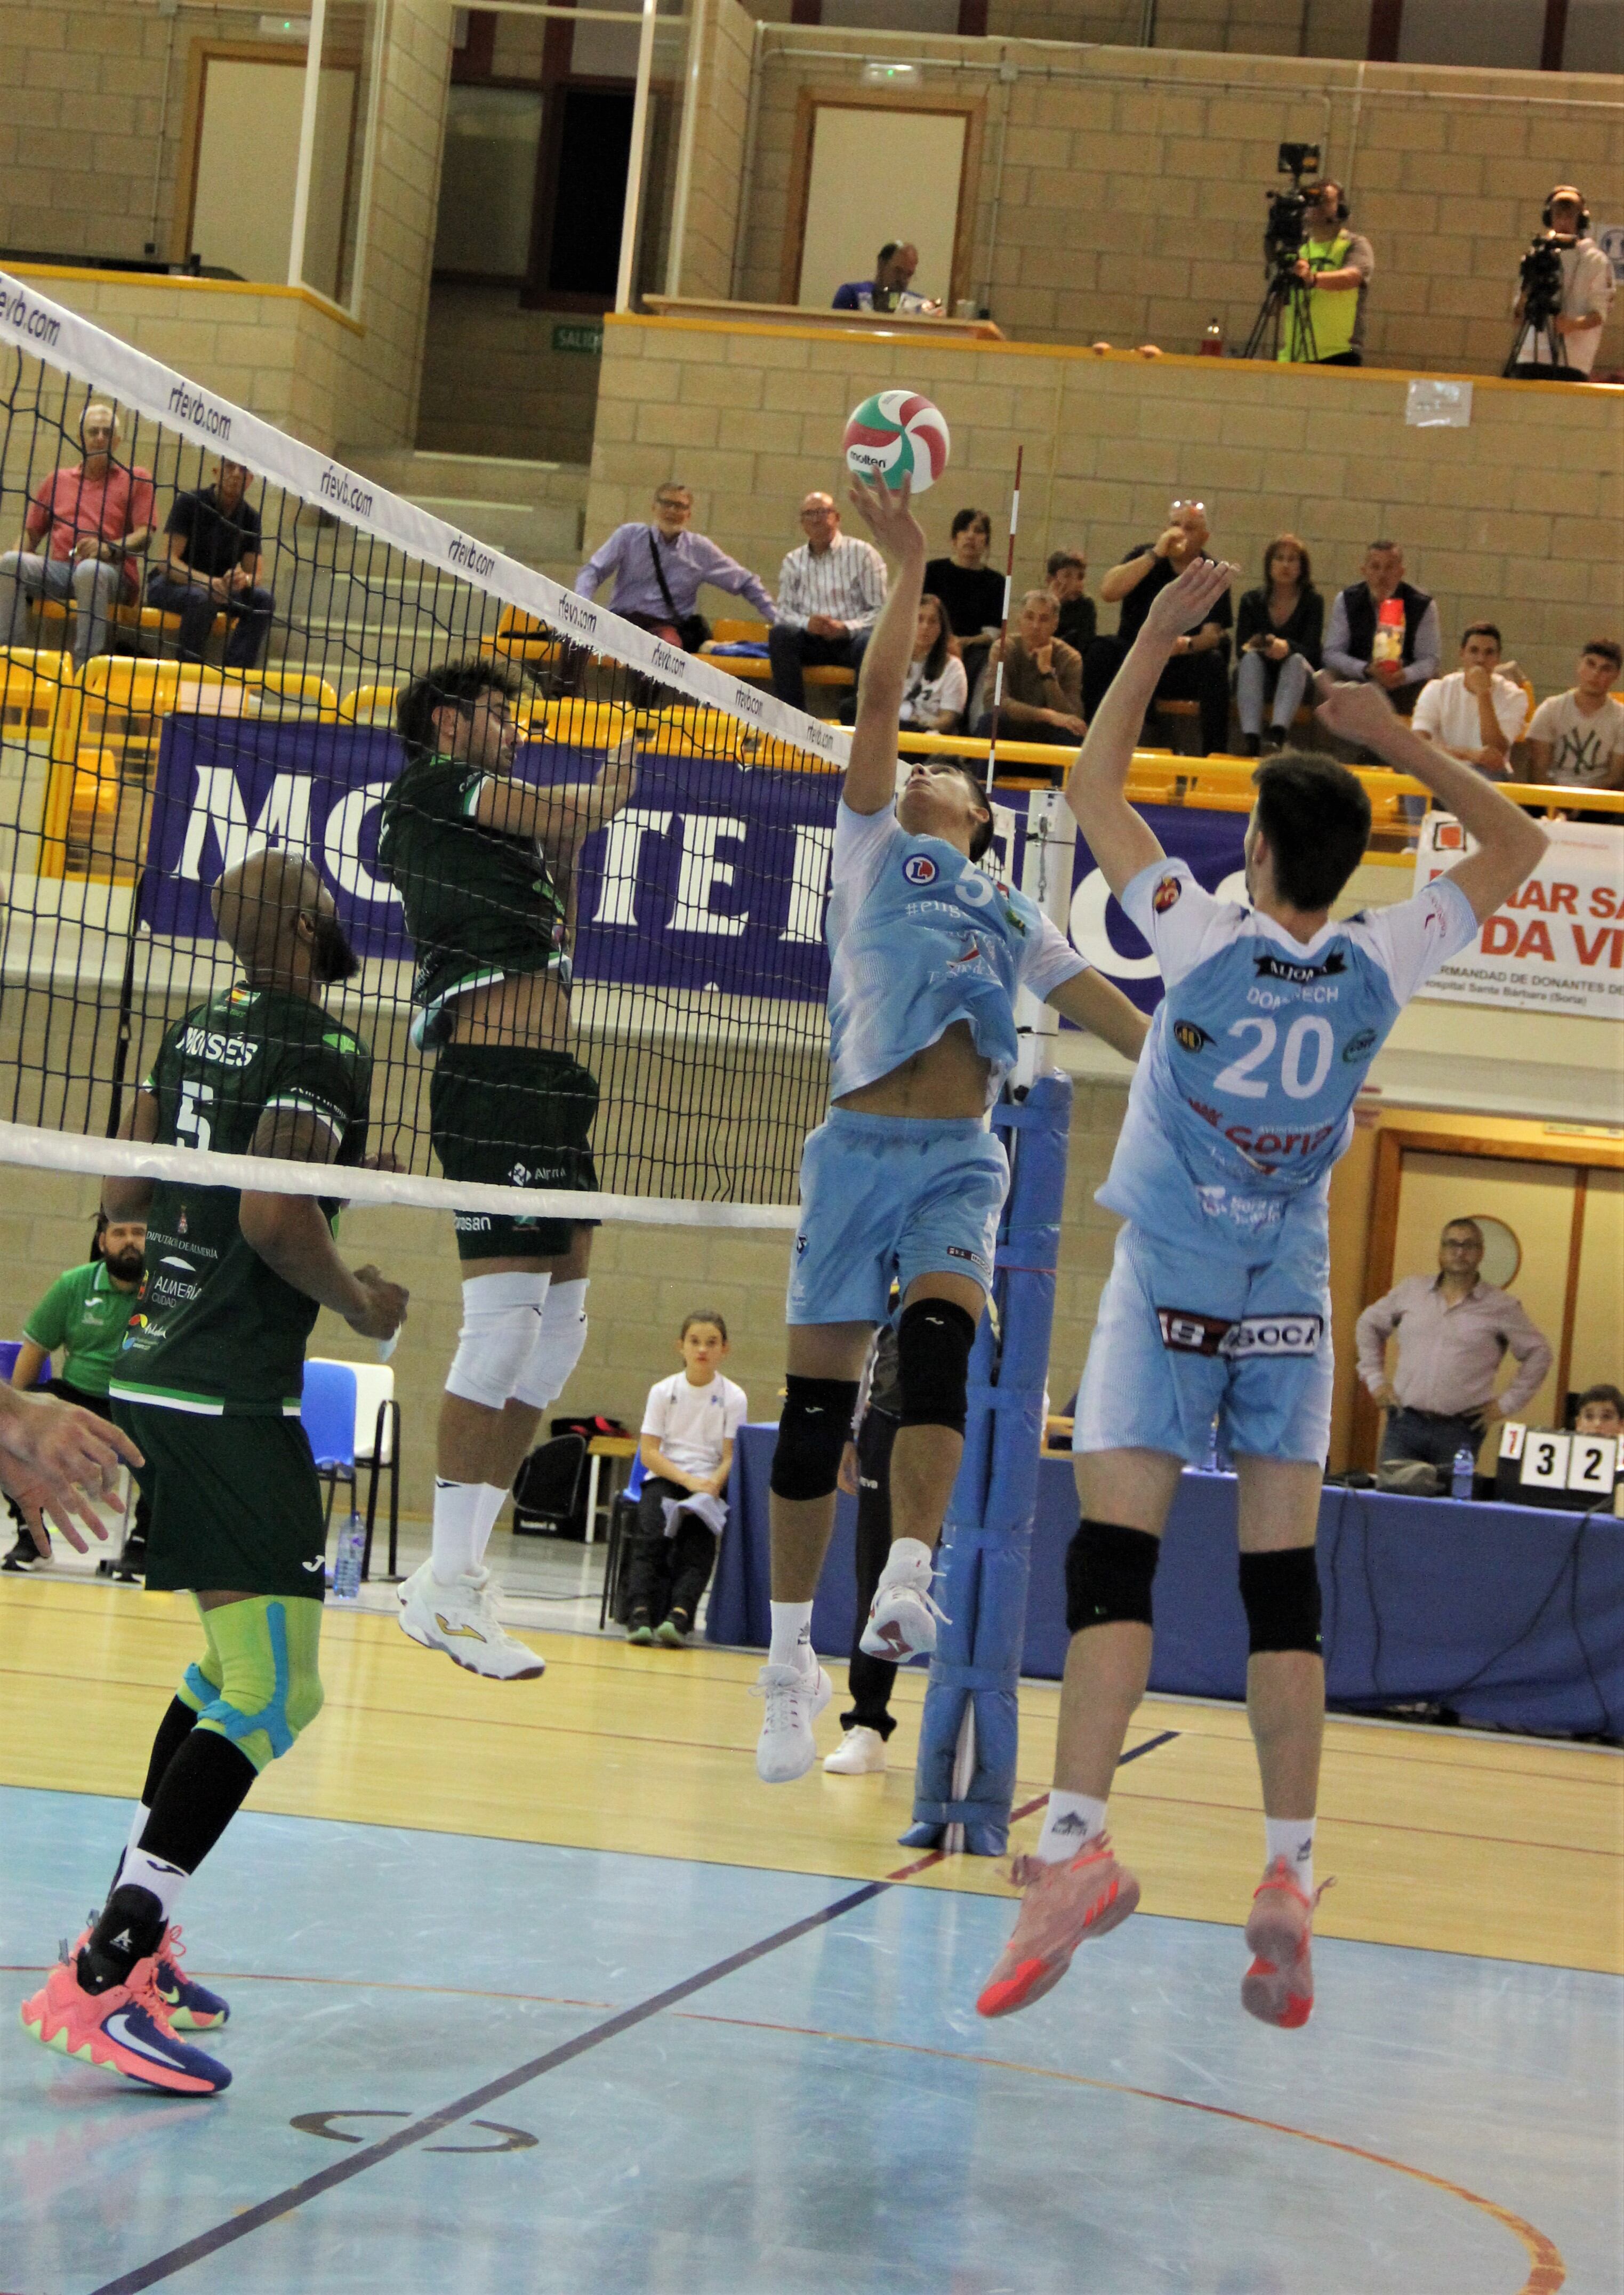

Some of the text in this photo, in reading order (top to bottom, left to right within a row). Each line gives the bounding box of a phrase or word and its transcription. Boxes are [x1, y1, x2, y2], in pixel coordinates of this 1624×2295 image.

[0, 278, 61, 346] evb.com
[850, 451, 887, 468] molten
[170, 765, 750, 937] MOTE
[955, 860, 993, 906] 5
[1481, 915, 1556, 962] DA
[1441, 965, 1507, 982] RMANDAD
[1510, 972, 1530, 984] DE
[1531, 975, 1604, 992] DONANTES
[175, 1026, 258, 1066] MOISÉS
[1213, 1015, 1333, 1100] 20
[176, 1080, 213, 1150] 5
[1537, 1443, 1556, 1475] 3
[1584, 1448, 1603, 1480] 2
